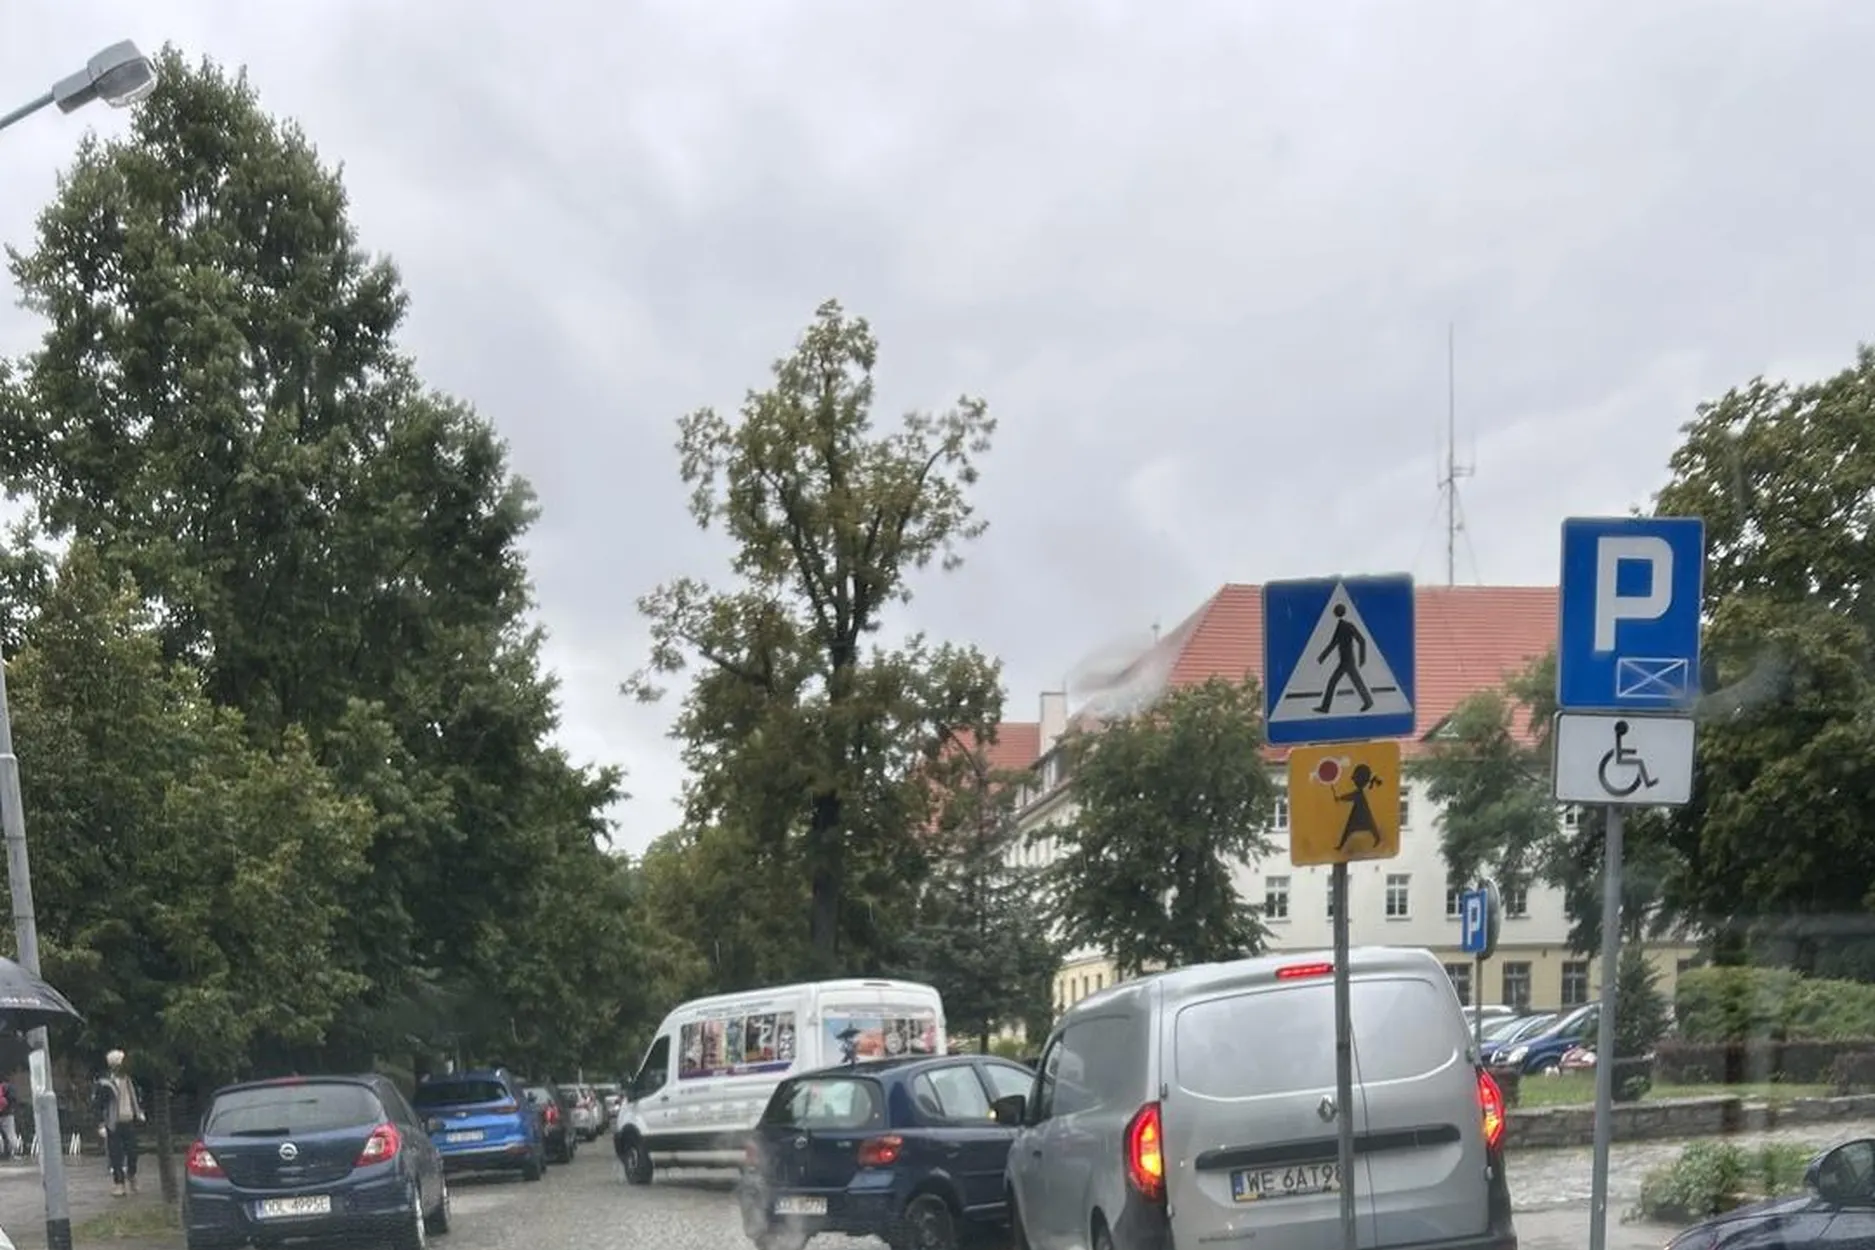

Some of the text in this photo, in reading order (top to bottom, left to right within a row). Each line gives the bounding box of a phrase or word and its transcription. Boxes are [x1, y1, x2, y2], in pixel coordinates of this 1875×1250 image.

[1595, 536, 1674, 652] P
[1467, 898, 1481, 946] P
[1246, 1171, 1276, 1192] WE
